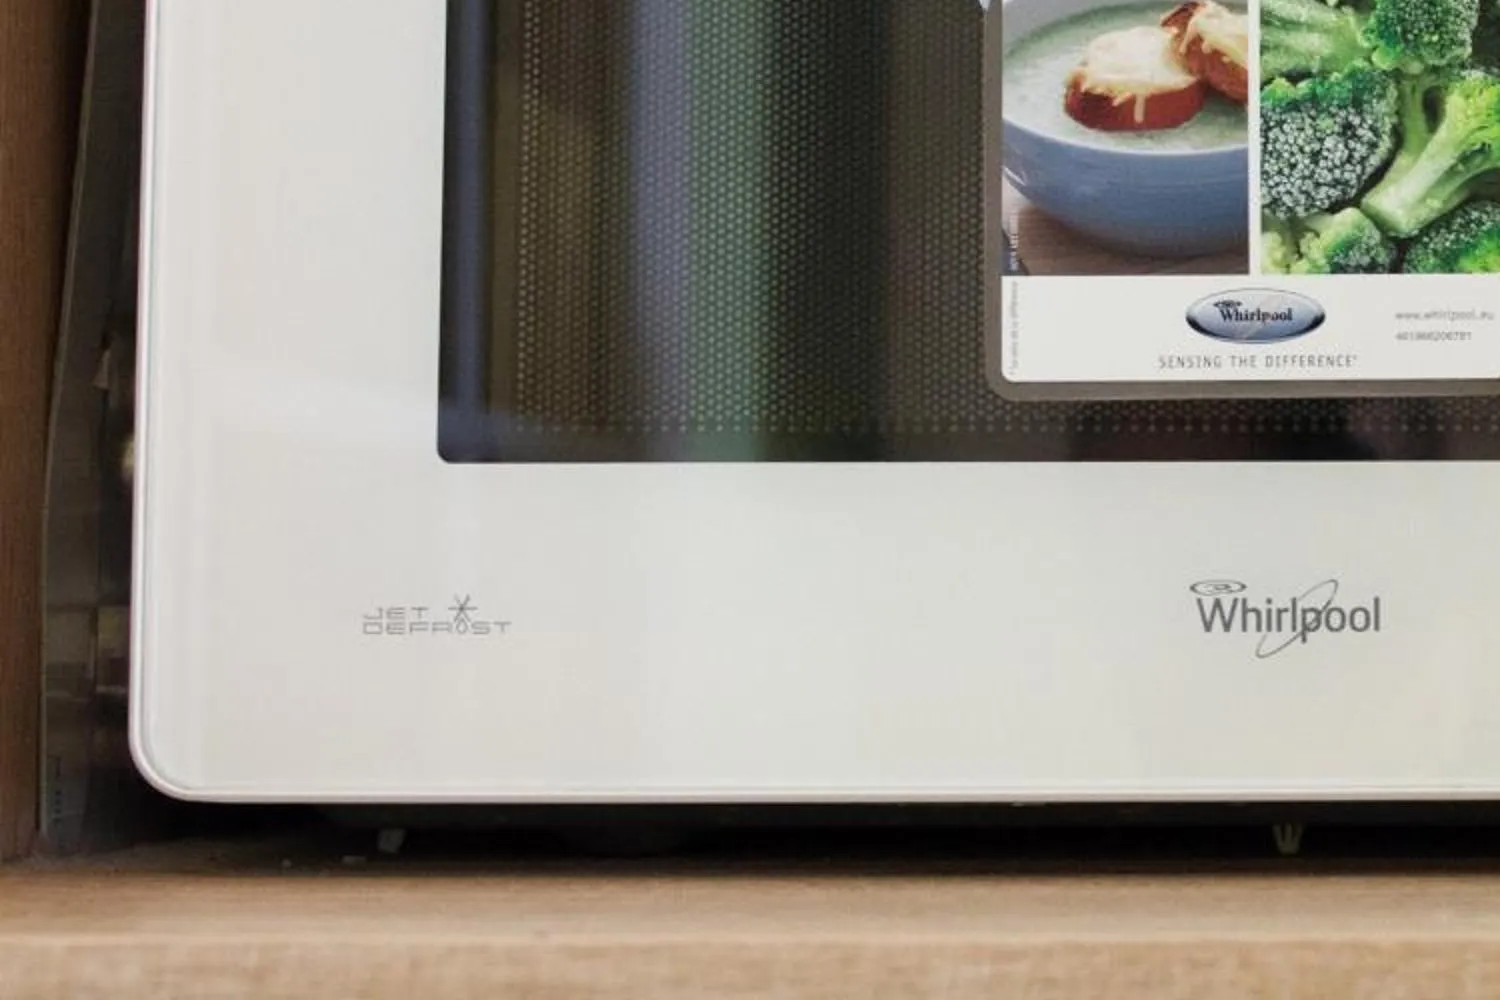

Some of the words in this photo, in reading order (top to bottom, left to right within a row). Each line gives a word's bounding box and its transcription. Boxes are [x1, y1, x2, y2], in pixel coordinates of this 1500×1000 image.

[1219, 307, 1293, 325] Whirlpool
[1158, 355, 1222, 369] SENSING
[1230, 355, 1257, 368] THE
[362, 606, 430, 620] JET
[1195, 596, 1381, 644] Whirlpool
